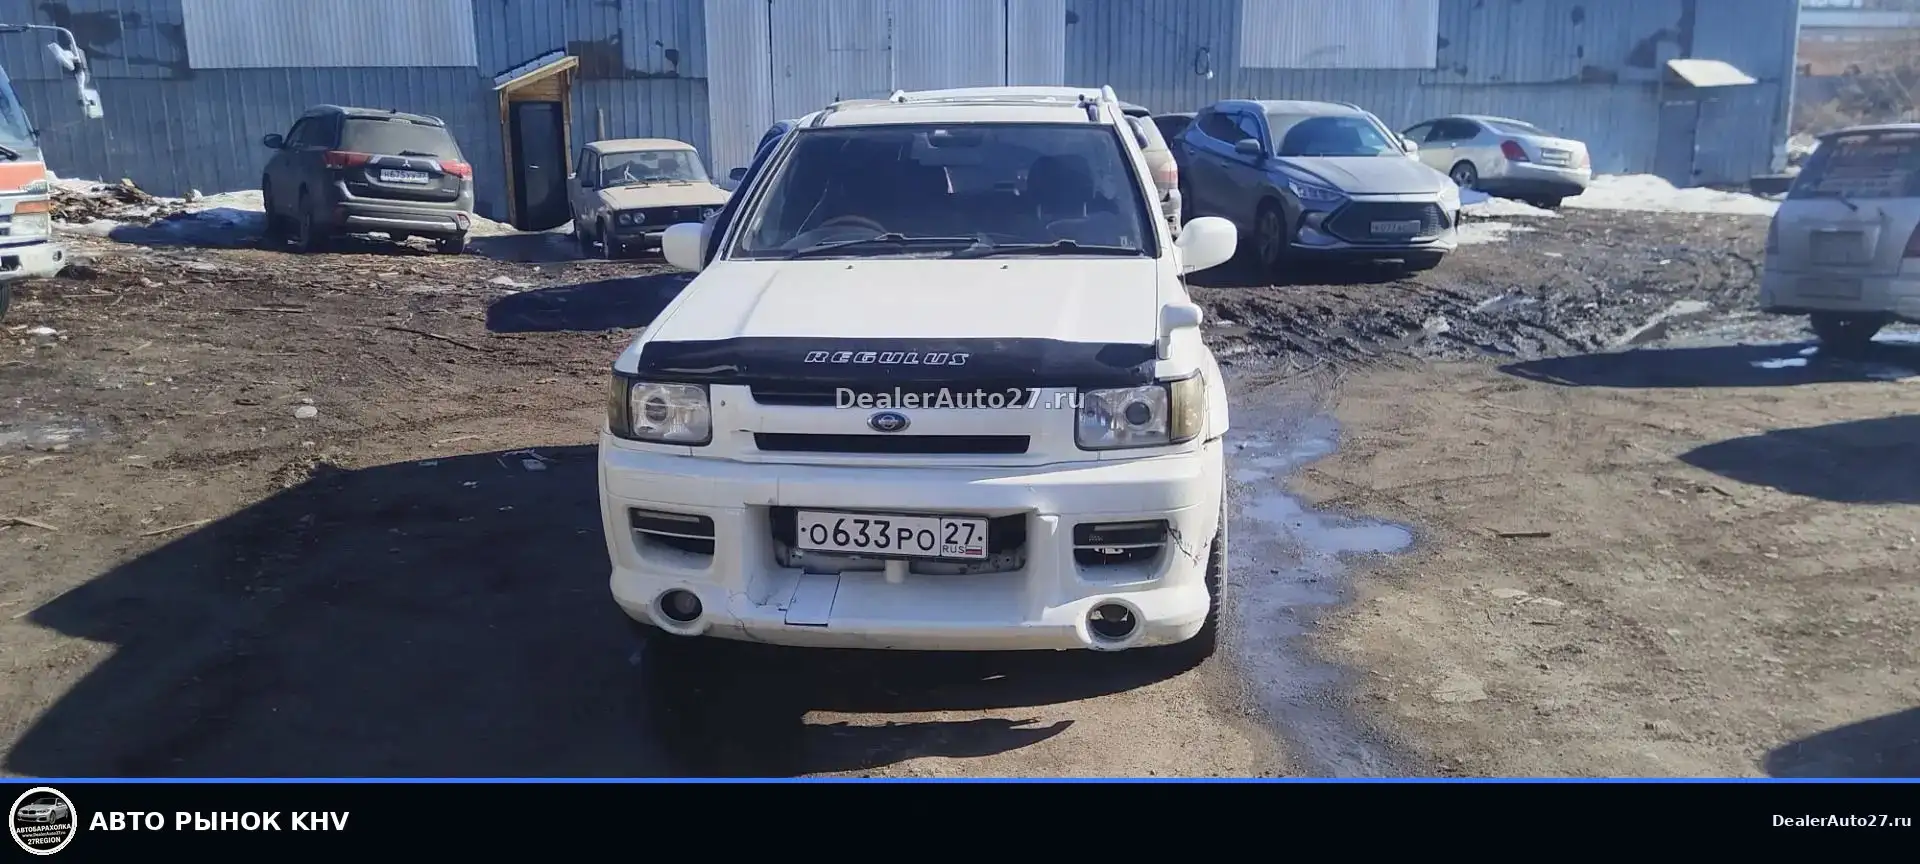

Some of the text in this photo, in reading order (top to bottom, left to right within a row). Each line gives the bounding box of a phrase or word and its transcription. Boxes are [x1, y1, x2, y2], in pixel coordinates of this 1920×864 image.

[804, 351, 971, 366] REGULUS
[944, 522, 976, 545] 27
[942, 545, 965, 554] RUS
